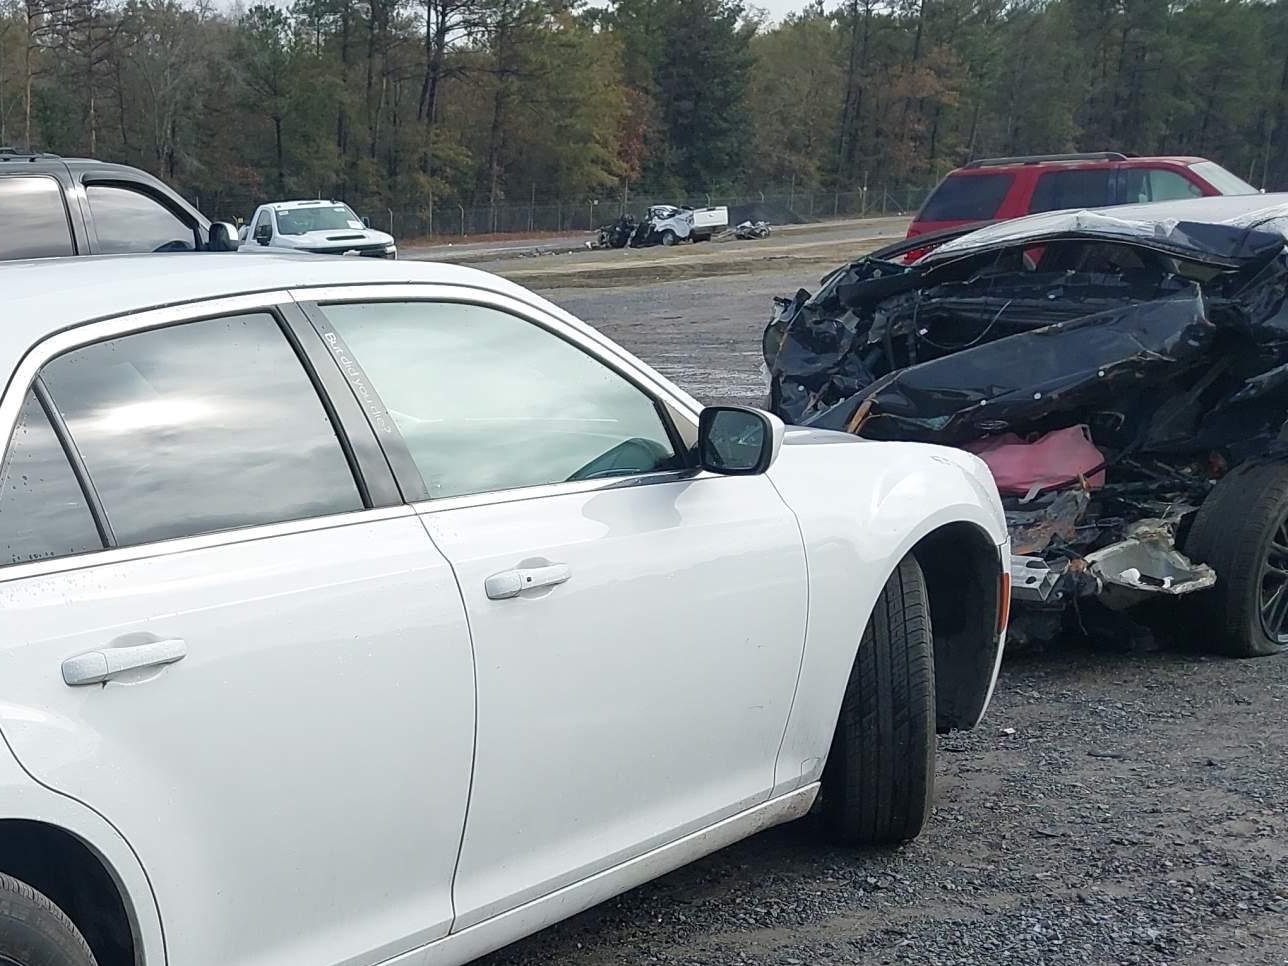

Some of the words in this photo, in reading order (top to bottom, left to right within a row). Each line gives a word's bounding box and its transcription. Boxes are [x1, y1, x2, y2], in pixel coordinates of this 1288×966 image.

[324, 332, 344, 354] But
[341, 356, 360, 377] did
[352, 379, 372, 403] you
